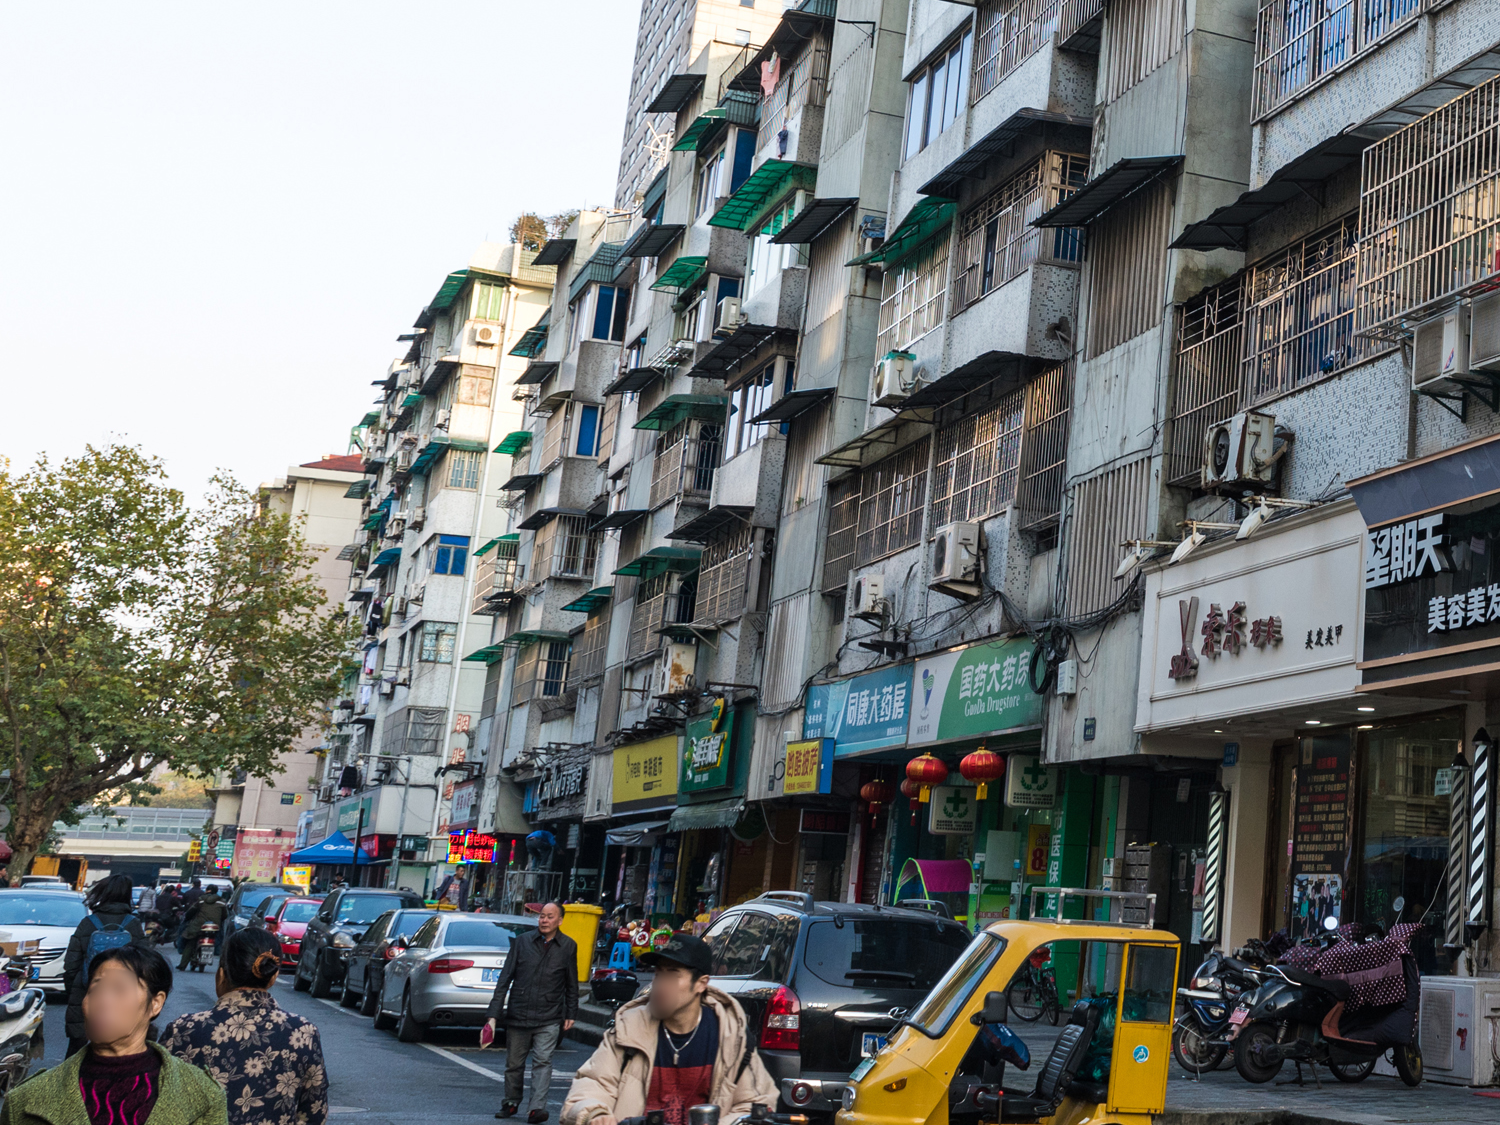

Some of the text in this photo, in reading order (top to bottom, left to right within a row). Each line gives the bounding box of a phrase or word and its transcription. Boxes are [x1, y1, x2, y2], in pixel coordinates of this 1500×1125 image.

[1366, 512, 1444, 590] 星期天
[1304, 623, 1344, 650] 美发美甲
[959, 649, 1031, 700] 国药大药房
[845, 681, 907, 727] 同康大药房
[986, 694, 1021, 716] Drugstore
[294, 795, 302, 804] 2
[1045, 809, 1064, 920] 市医保定
